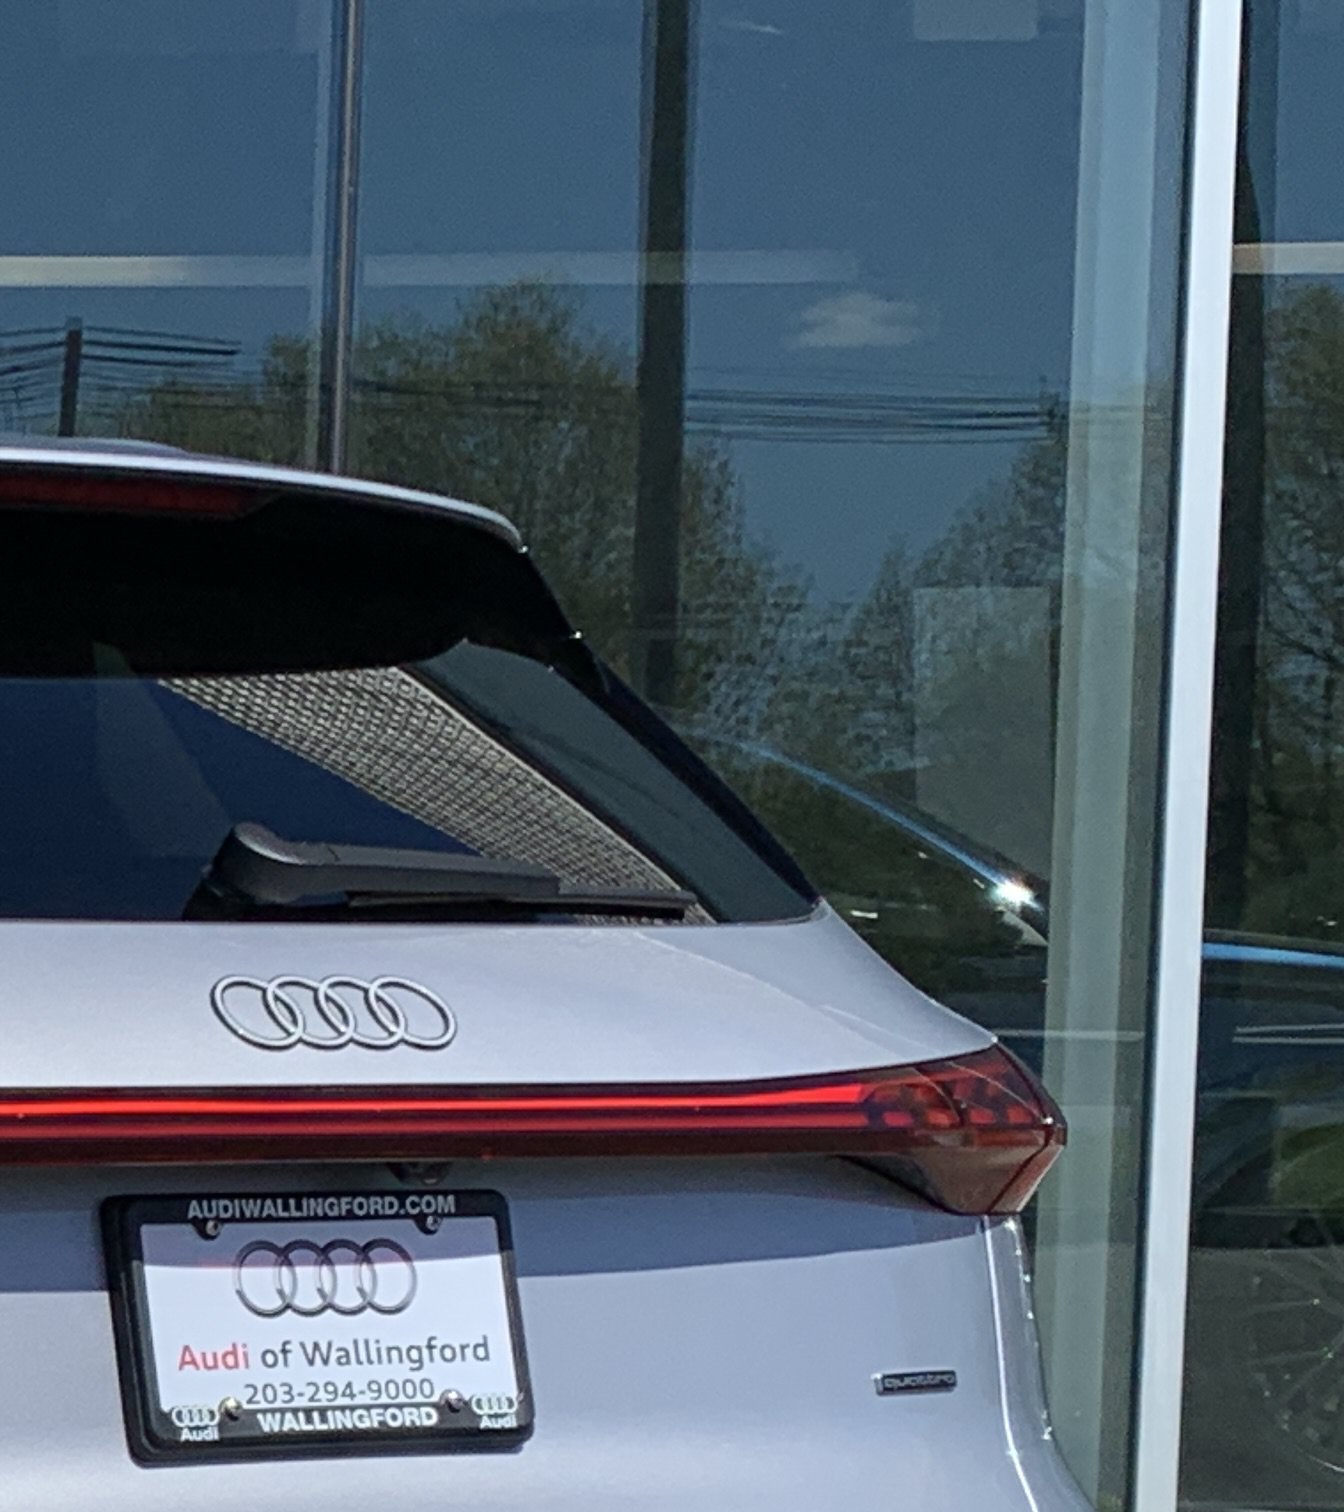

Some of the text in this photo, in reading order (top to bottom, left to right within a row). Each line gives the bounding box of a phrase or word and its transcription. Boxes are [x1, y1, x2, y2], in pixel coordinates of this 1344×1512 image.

[188, 1195, 456, 1219] AUDIWALLINGFORD.COM
[178, 1334, 490, 1371] Audi of Wallingford
[244, 1378, 435, 1405] 203-294-9000
[257, 1406, 439, 1432] WALLINGFORD
[479, 1414, 518, 1430] Audi
[180, 1427, 219, 1442] Audi
